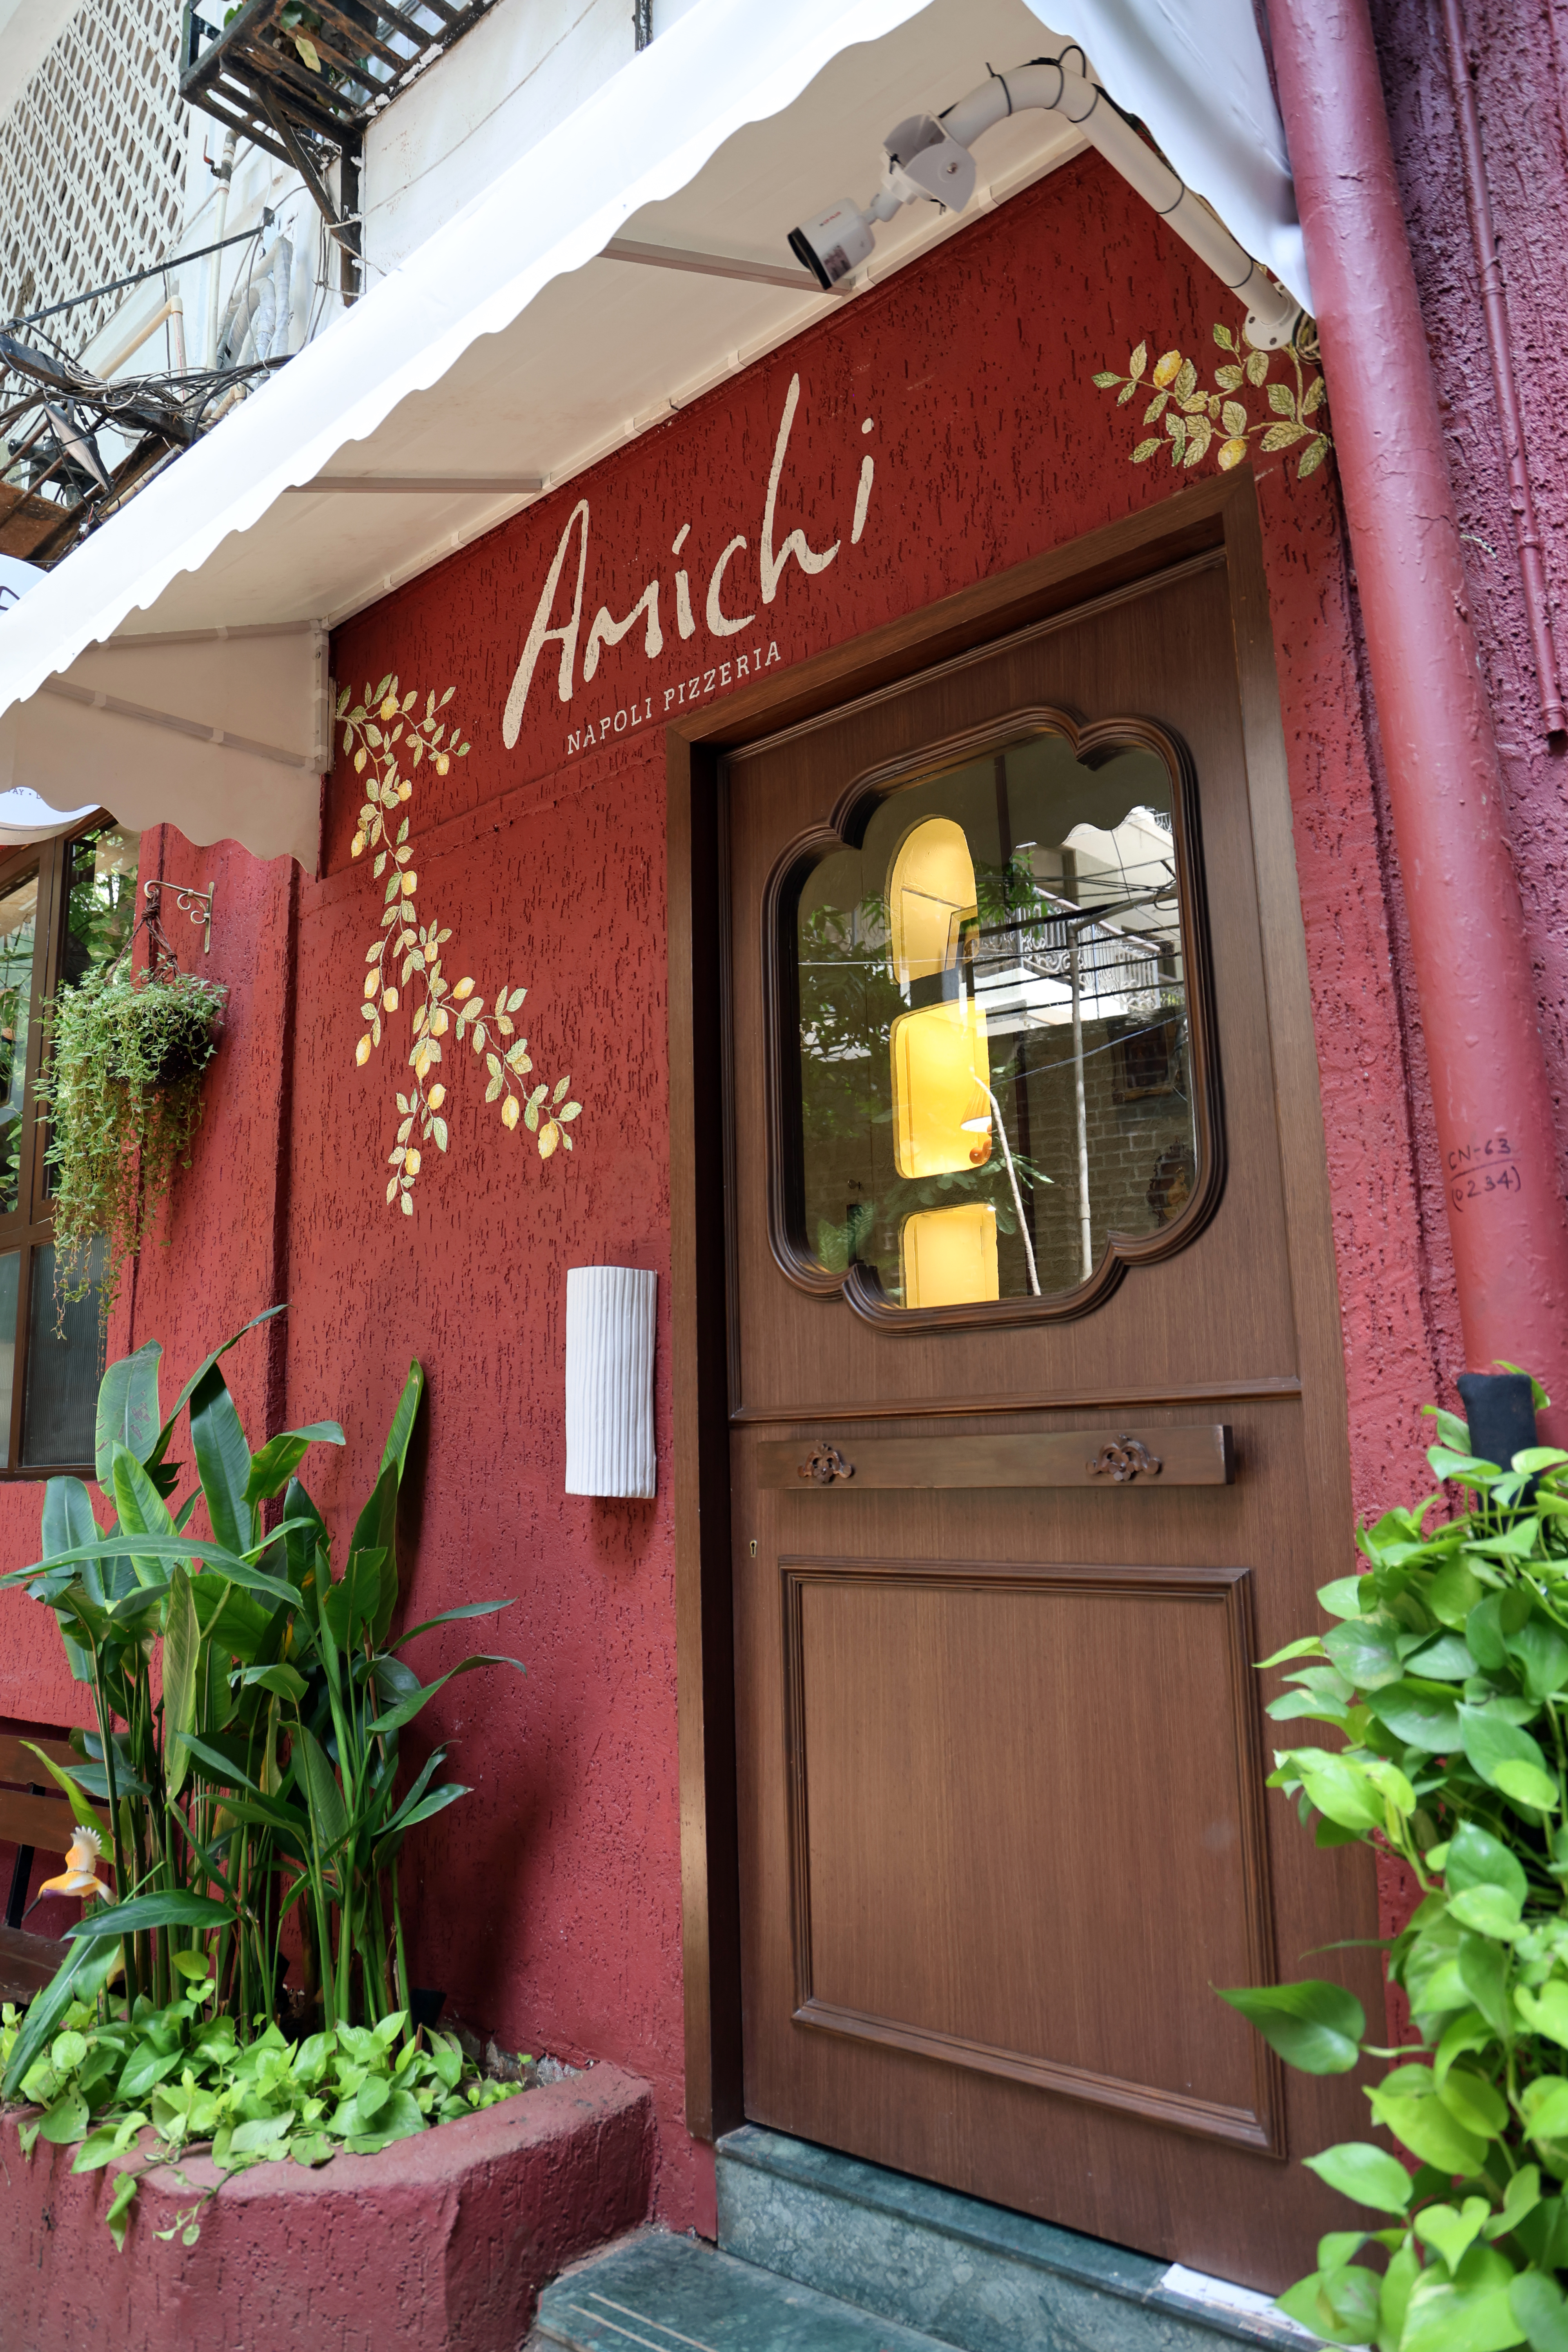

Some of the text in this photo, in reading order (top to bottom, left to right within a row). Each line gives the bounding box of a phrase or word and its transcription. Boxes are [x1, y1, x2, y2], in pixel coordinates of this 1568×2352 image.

[502, 373, 874, 749] Amichi
[567, 641, 781, 755] NAPOLI PIZZERIA
